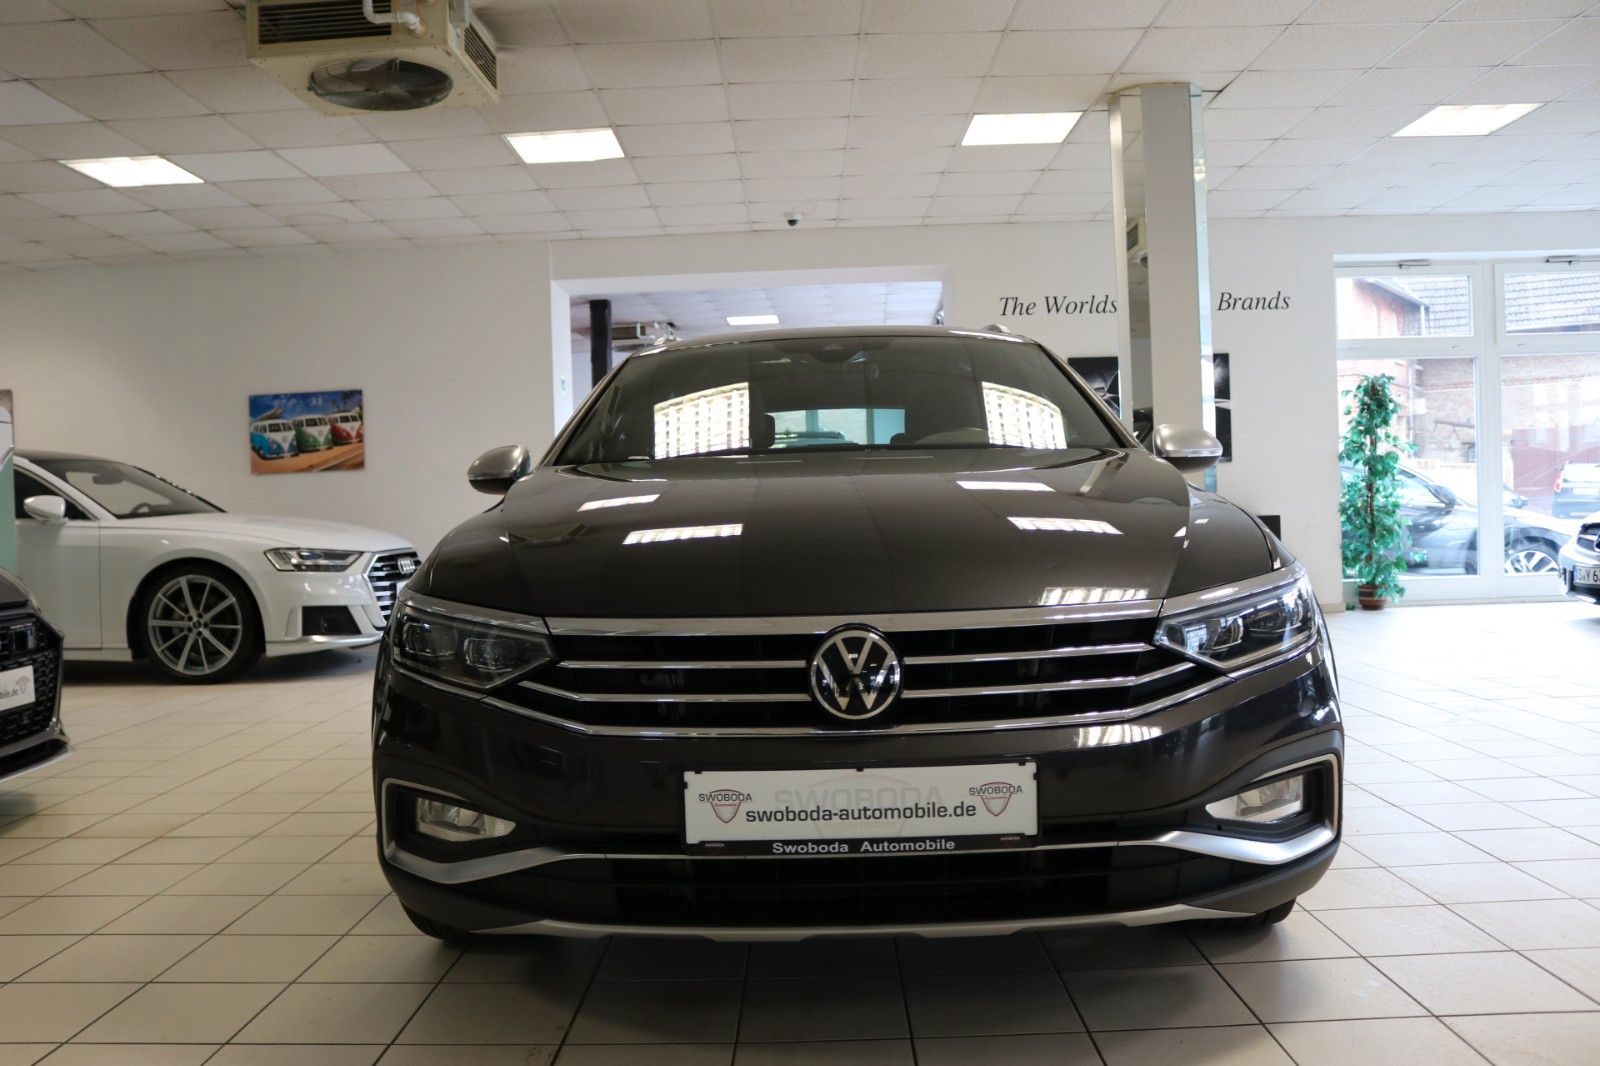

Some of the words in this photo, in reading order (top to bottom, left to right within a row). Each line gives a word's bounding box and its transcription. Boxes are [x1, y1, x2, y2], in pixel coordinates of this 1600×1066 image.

[999, 296, 1036, 316] The
[1044, 294, 1119, 315] Worlds
[1216, 290, 1291, 311] Brands
[698, 793, 753, 802] SWOBODA
[968, 785, 1023, 796] SWOBODA
[745, 801, 977, 823] swoboda-automobile.de
[772, 841, 849, 854] Swoboda
[859, 838, 956, 852] Automobile
